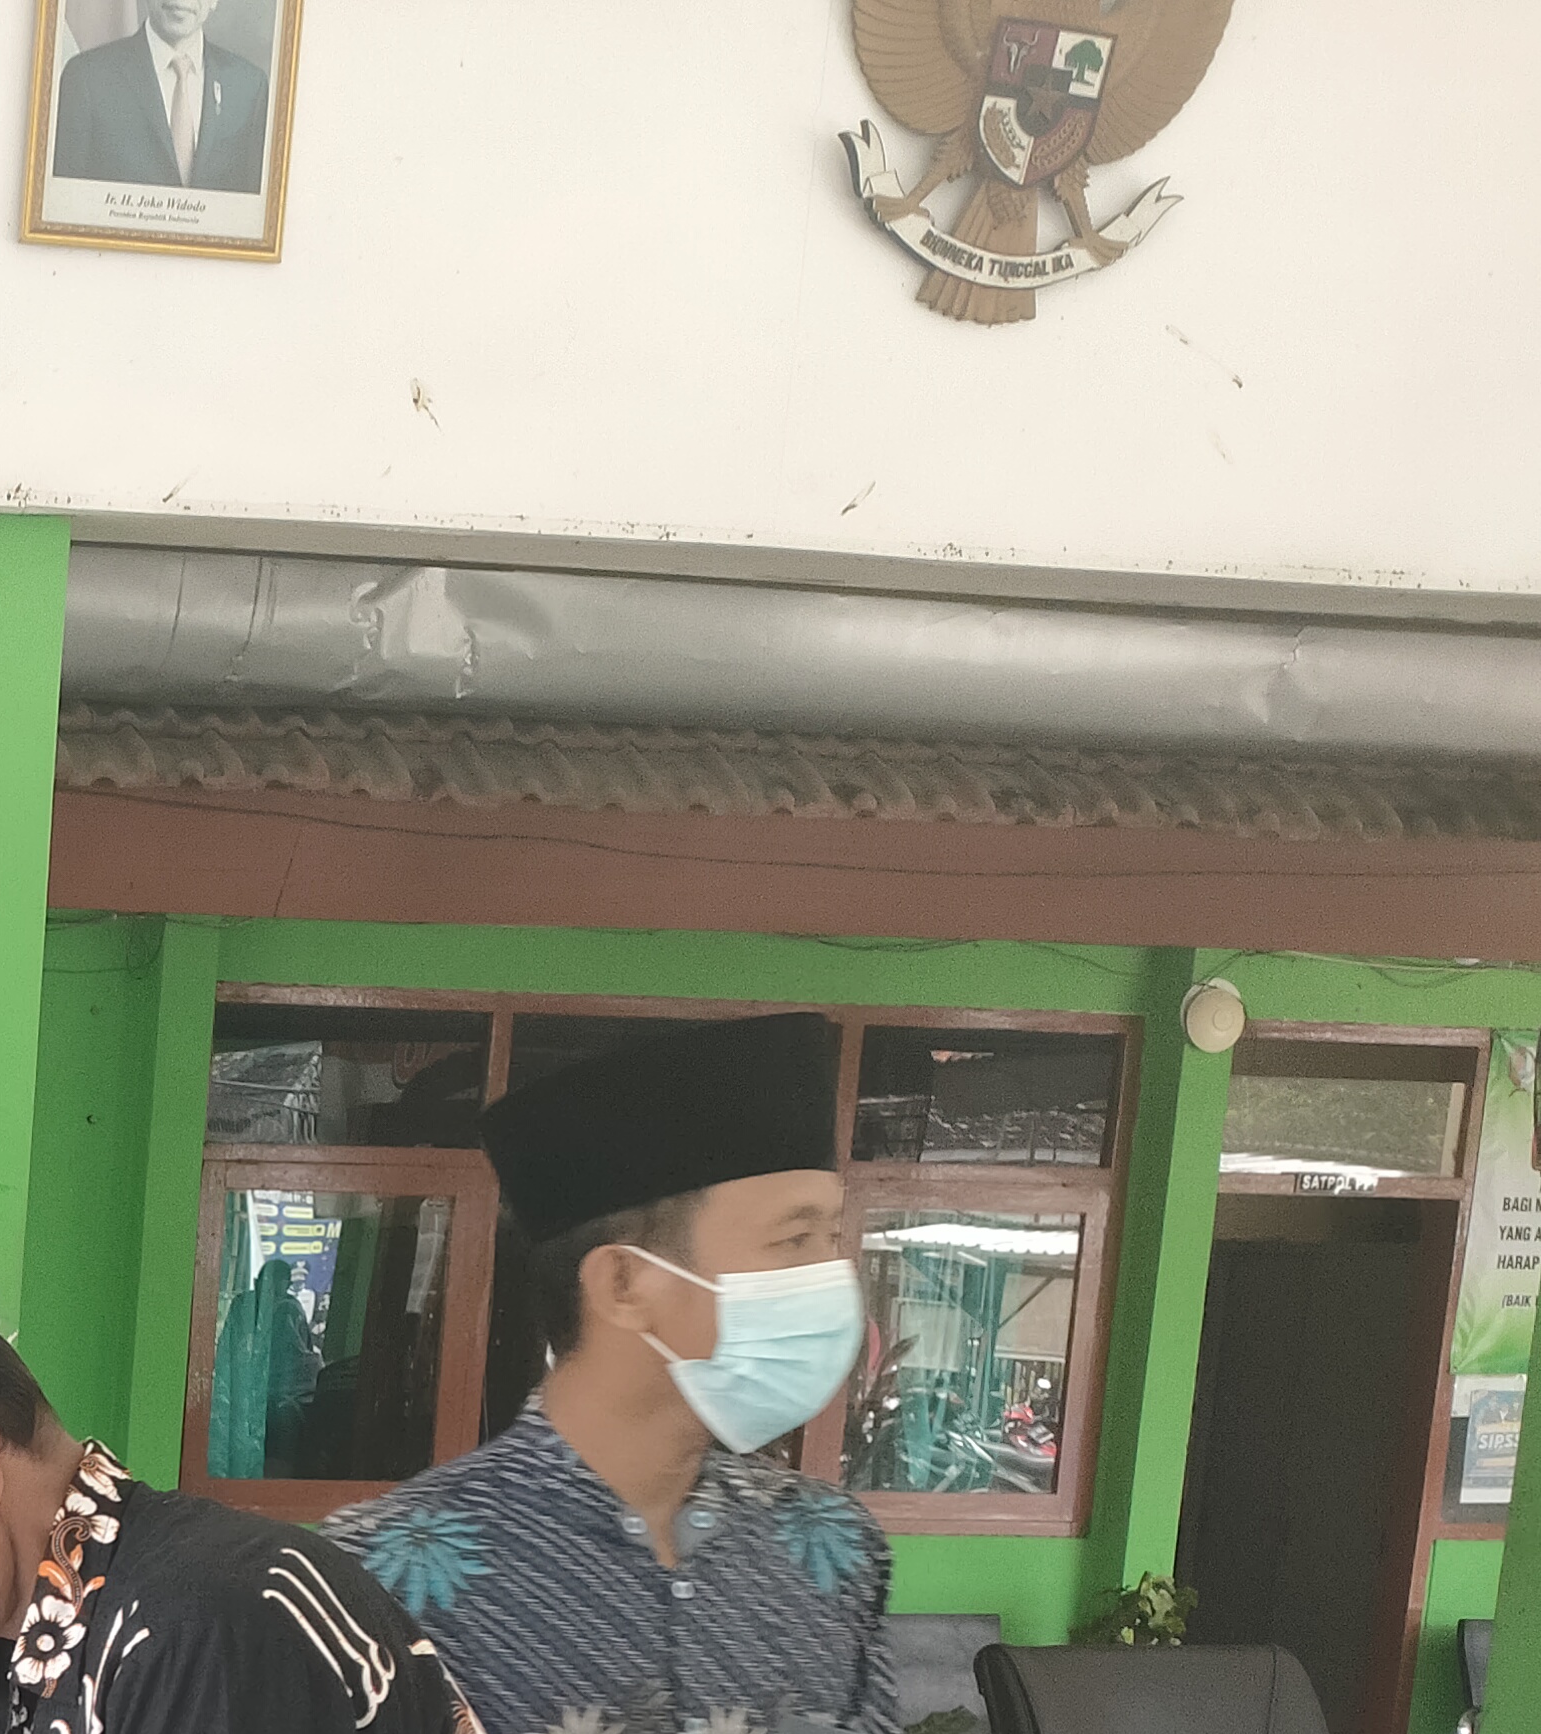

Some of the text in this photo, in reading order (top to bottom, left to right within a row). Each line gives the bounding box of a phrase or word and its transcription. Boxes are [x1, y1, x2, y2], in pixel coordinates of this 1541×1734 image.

[137, 195, 164, 208] Joko
[167, 198, 206, 212] Widodo
[1503, 1197, 1532, 1212] BAGI
[1499, 1225, 1532, 1241] YANG
[1497, 1255, 1540, 1270] HARAP
